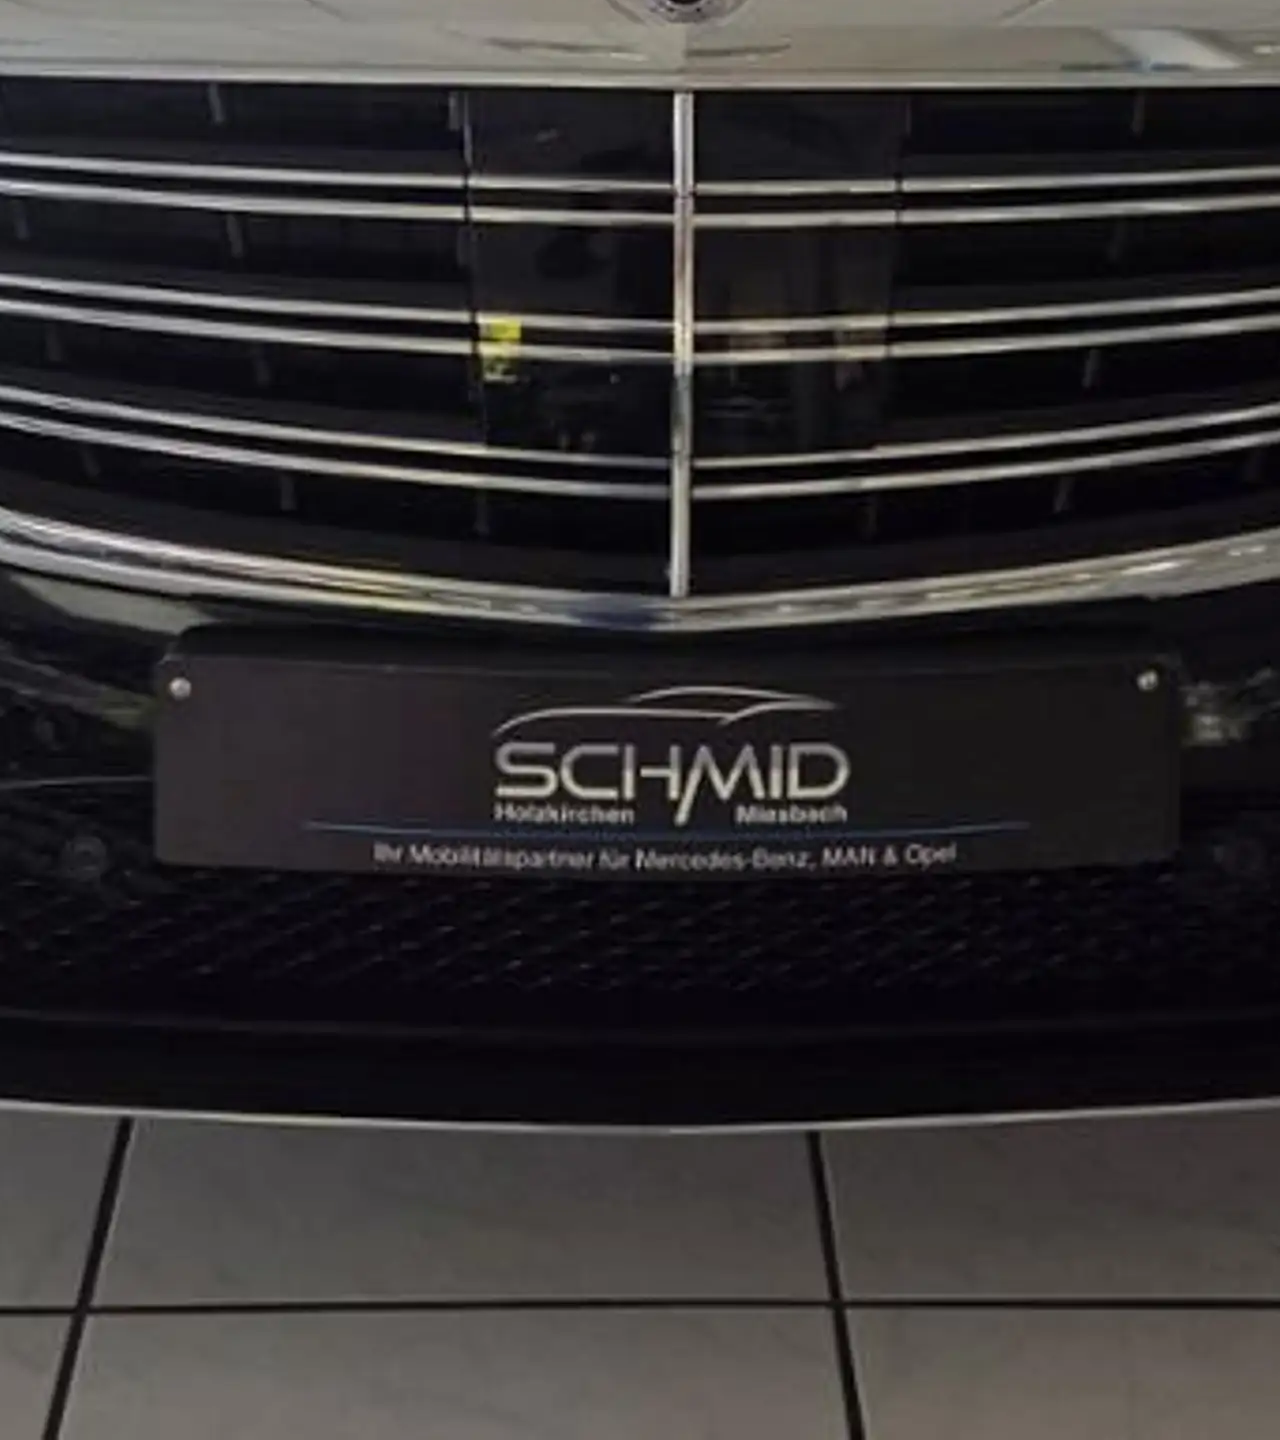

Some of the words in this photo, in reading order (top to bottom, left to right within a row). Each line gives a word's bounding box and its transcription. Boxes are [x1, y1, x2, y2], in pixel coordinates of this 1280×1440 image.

[494, 741, 851, 825] SCHMID
[494, 803, 635, 825] Holzkirchen
[736, 803, 848, 824] Miesbach
[822, 845, 875, 866] MAN
[882, 844, 899, 865] &
[905, 842, 958, 870] Opel
